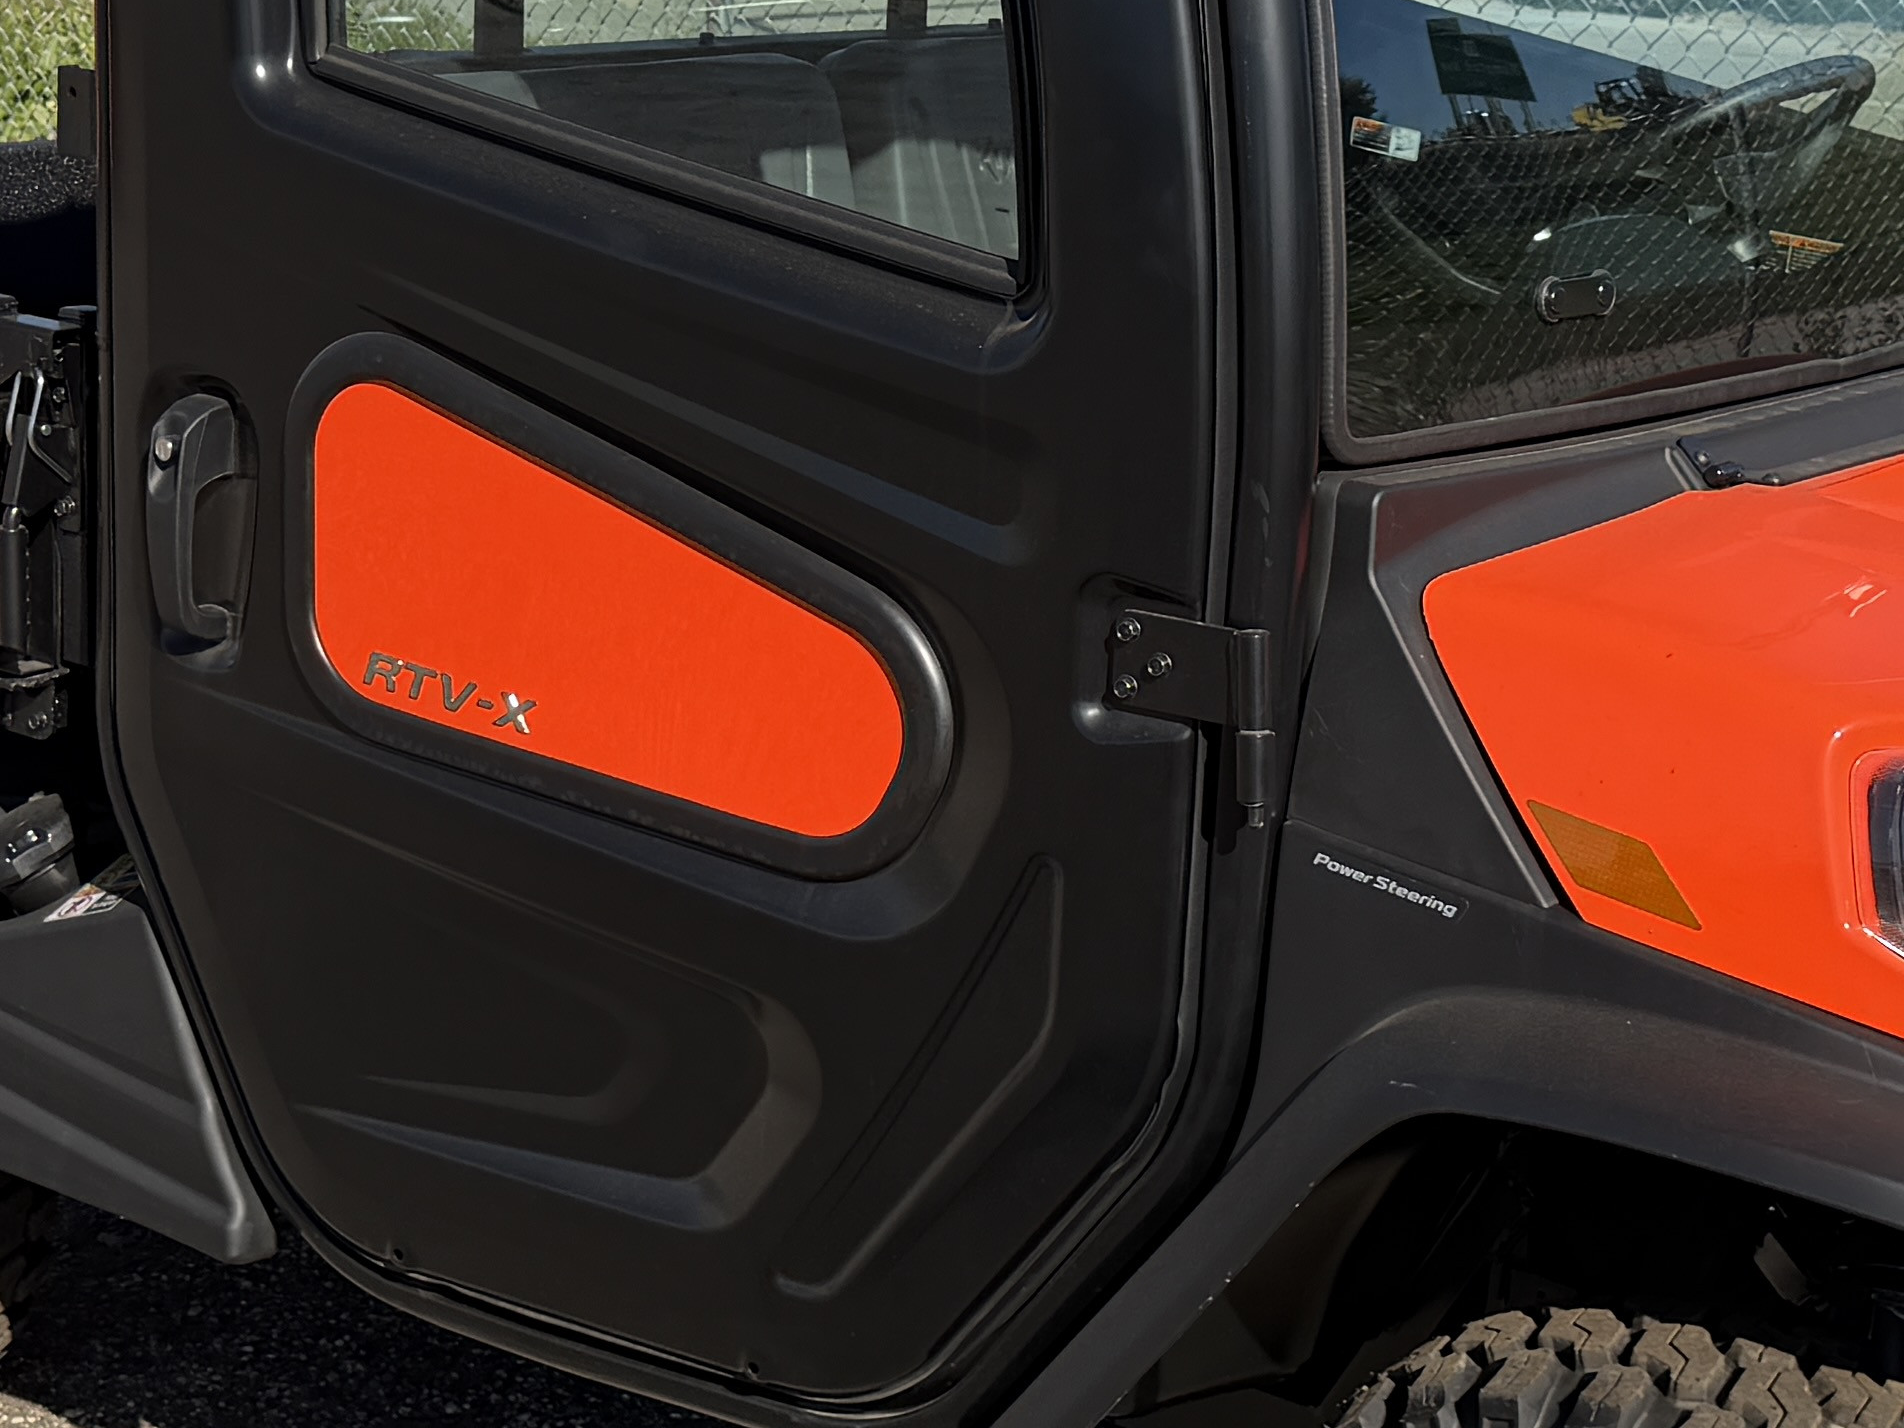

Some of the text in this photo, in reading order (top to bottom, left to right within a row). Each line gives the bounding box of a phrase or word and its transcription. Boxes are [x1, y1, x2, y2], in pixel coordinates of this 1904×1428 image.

[362, 652, 537, 735] RTV-X
[1313, 852, 1458, 918] Power Steering
